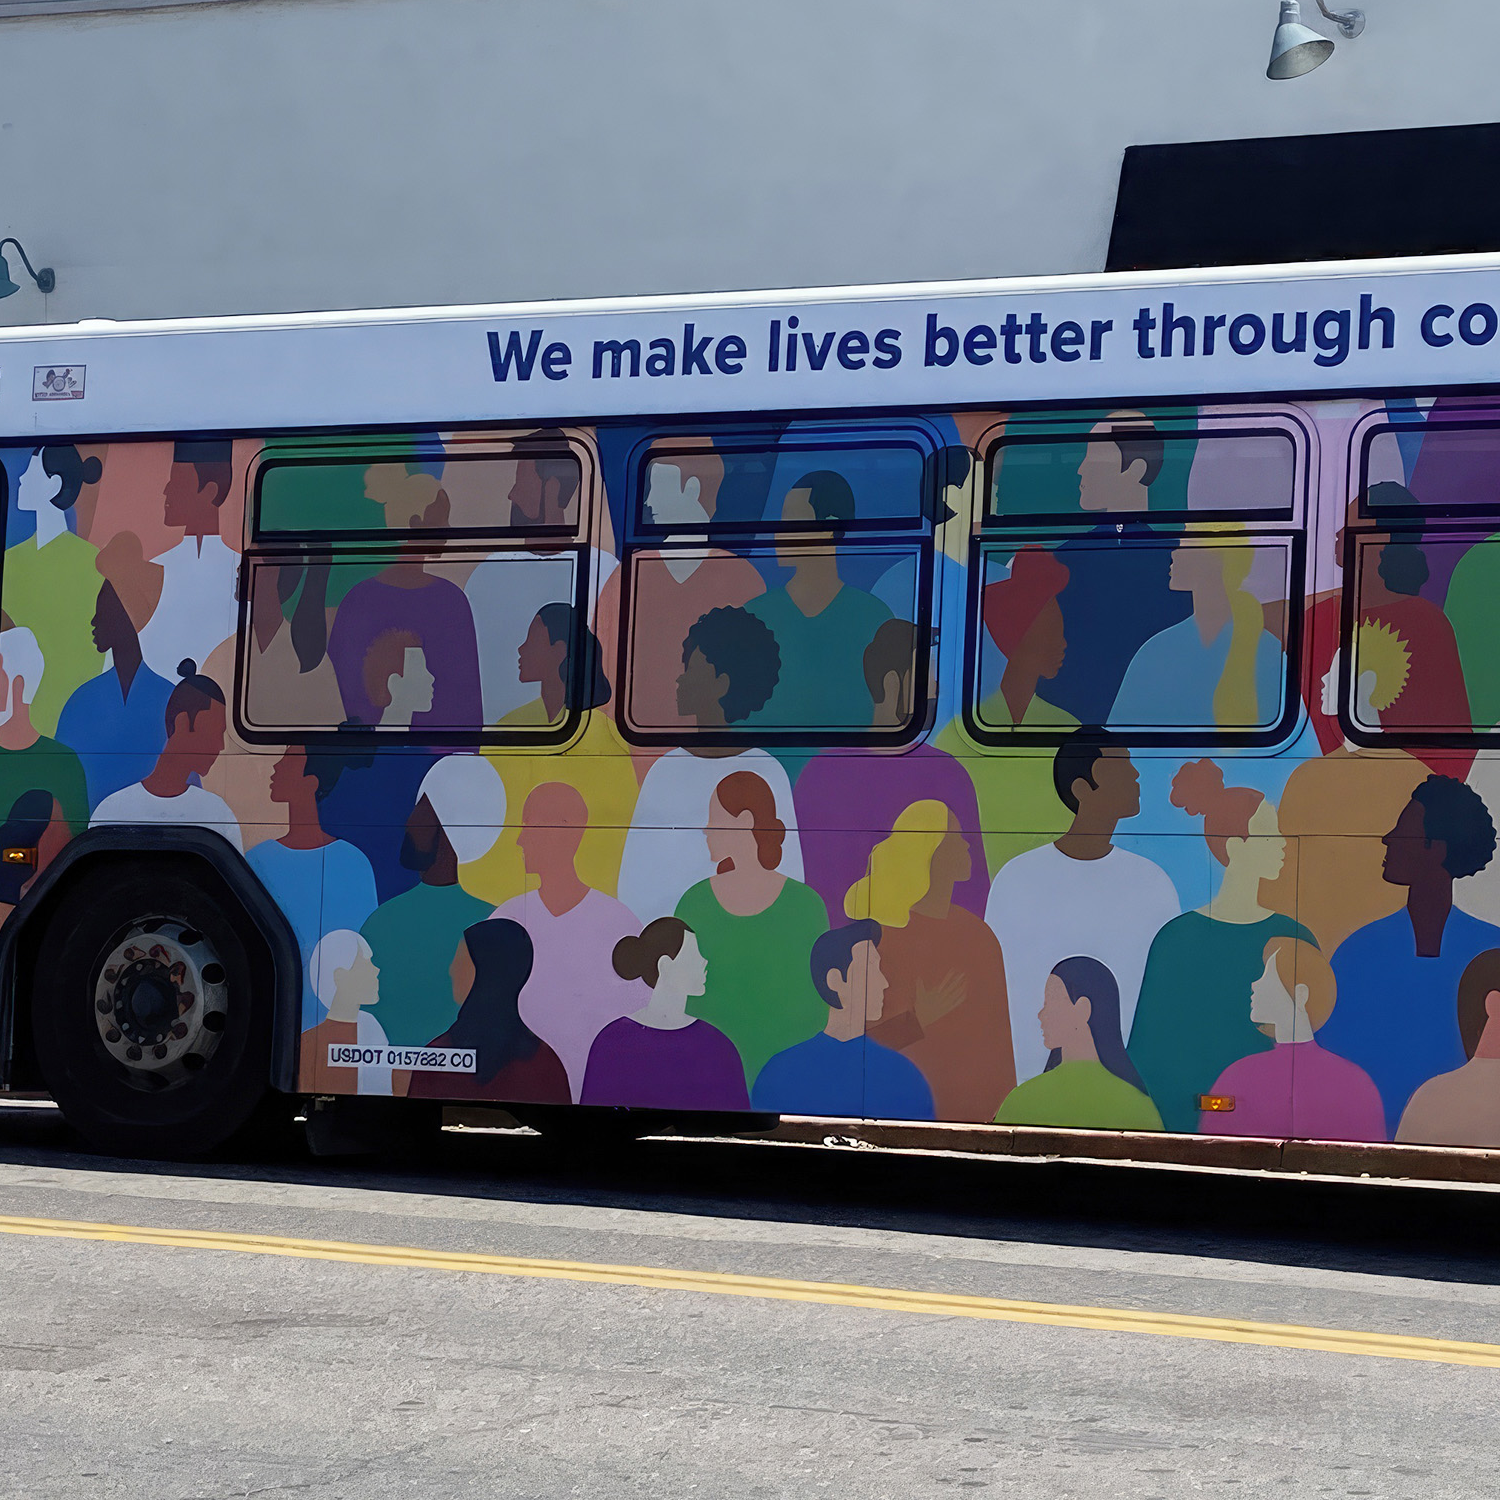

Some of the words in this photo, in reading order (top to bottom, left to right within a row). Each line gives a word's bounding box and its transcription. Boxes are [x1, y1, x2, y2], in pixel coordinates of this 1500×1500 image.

[486, 329, 572, 382] We
[591, 323, 747, 379] make
[768, 315, 902, 372] lives
[924, 312, 1113, 367] better
[1133, 293, 1396, 367] through
[331, 1048, 383, 1064] USDOT
[450, 1052, 474, 1068] CO
